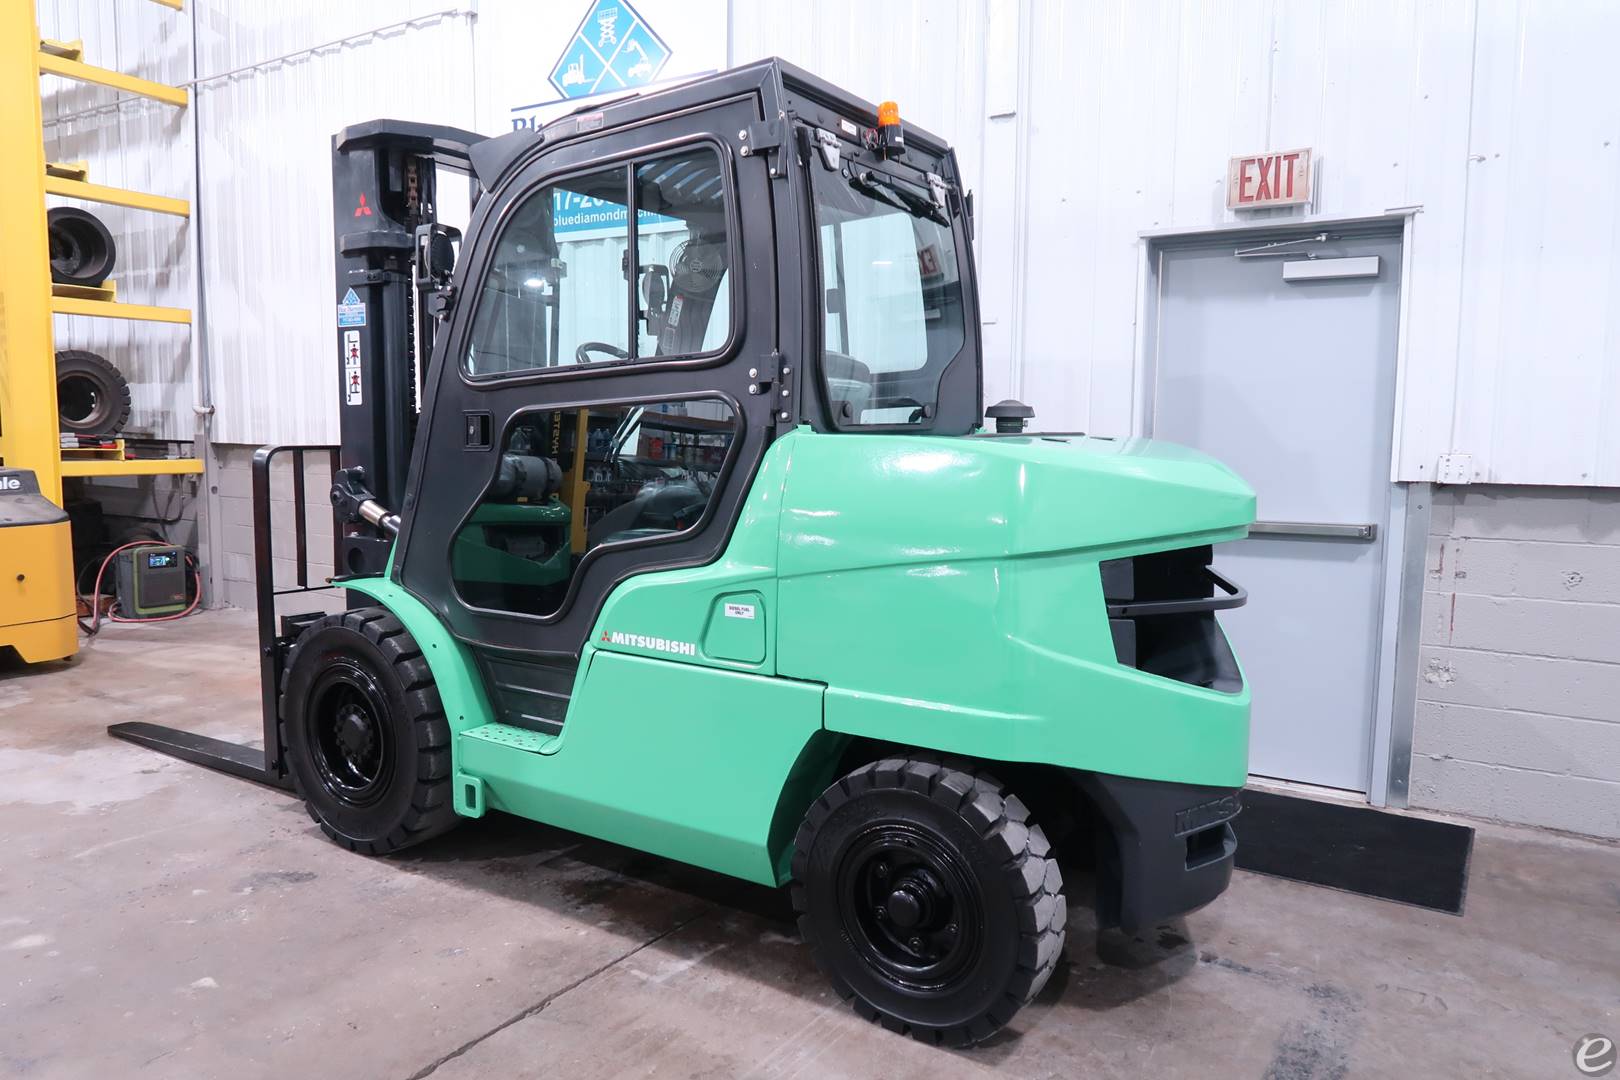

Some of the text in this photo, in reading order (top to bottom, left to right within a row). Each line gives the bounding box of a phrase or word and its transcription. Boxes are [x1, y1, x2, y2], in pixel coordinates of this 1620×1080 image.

[1239, 153, 1299, 202] EXIT
[0, 476, 21, 489] le
[611, 631, 696, 656] MITSUBISHI
